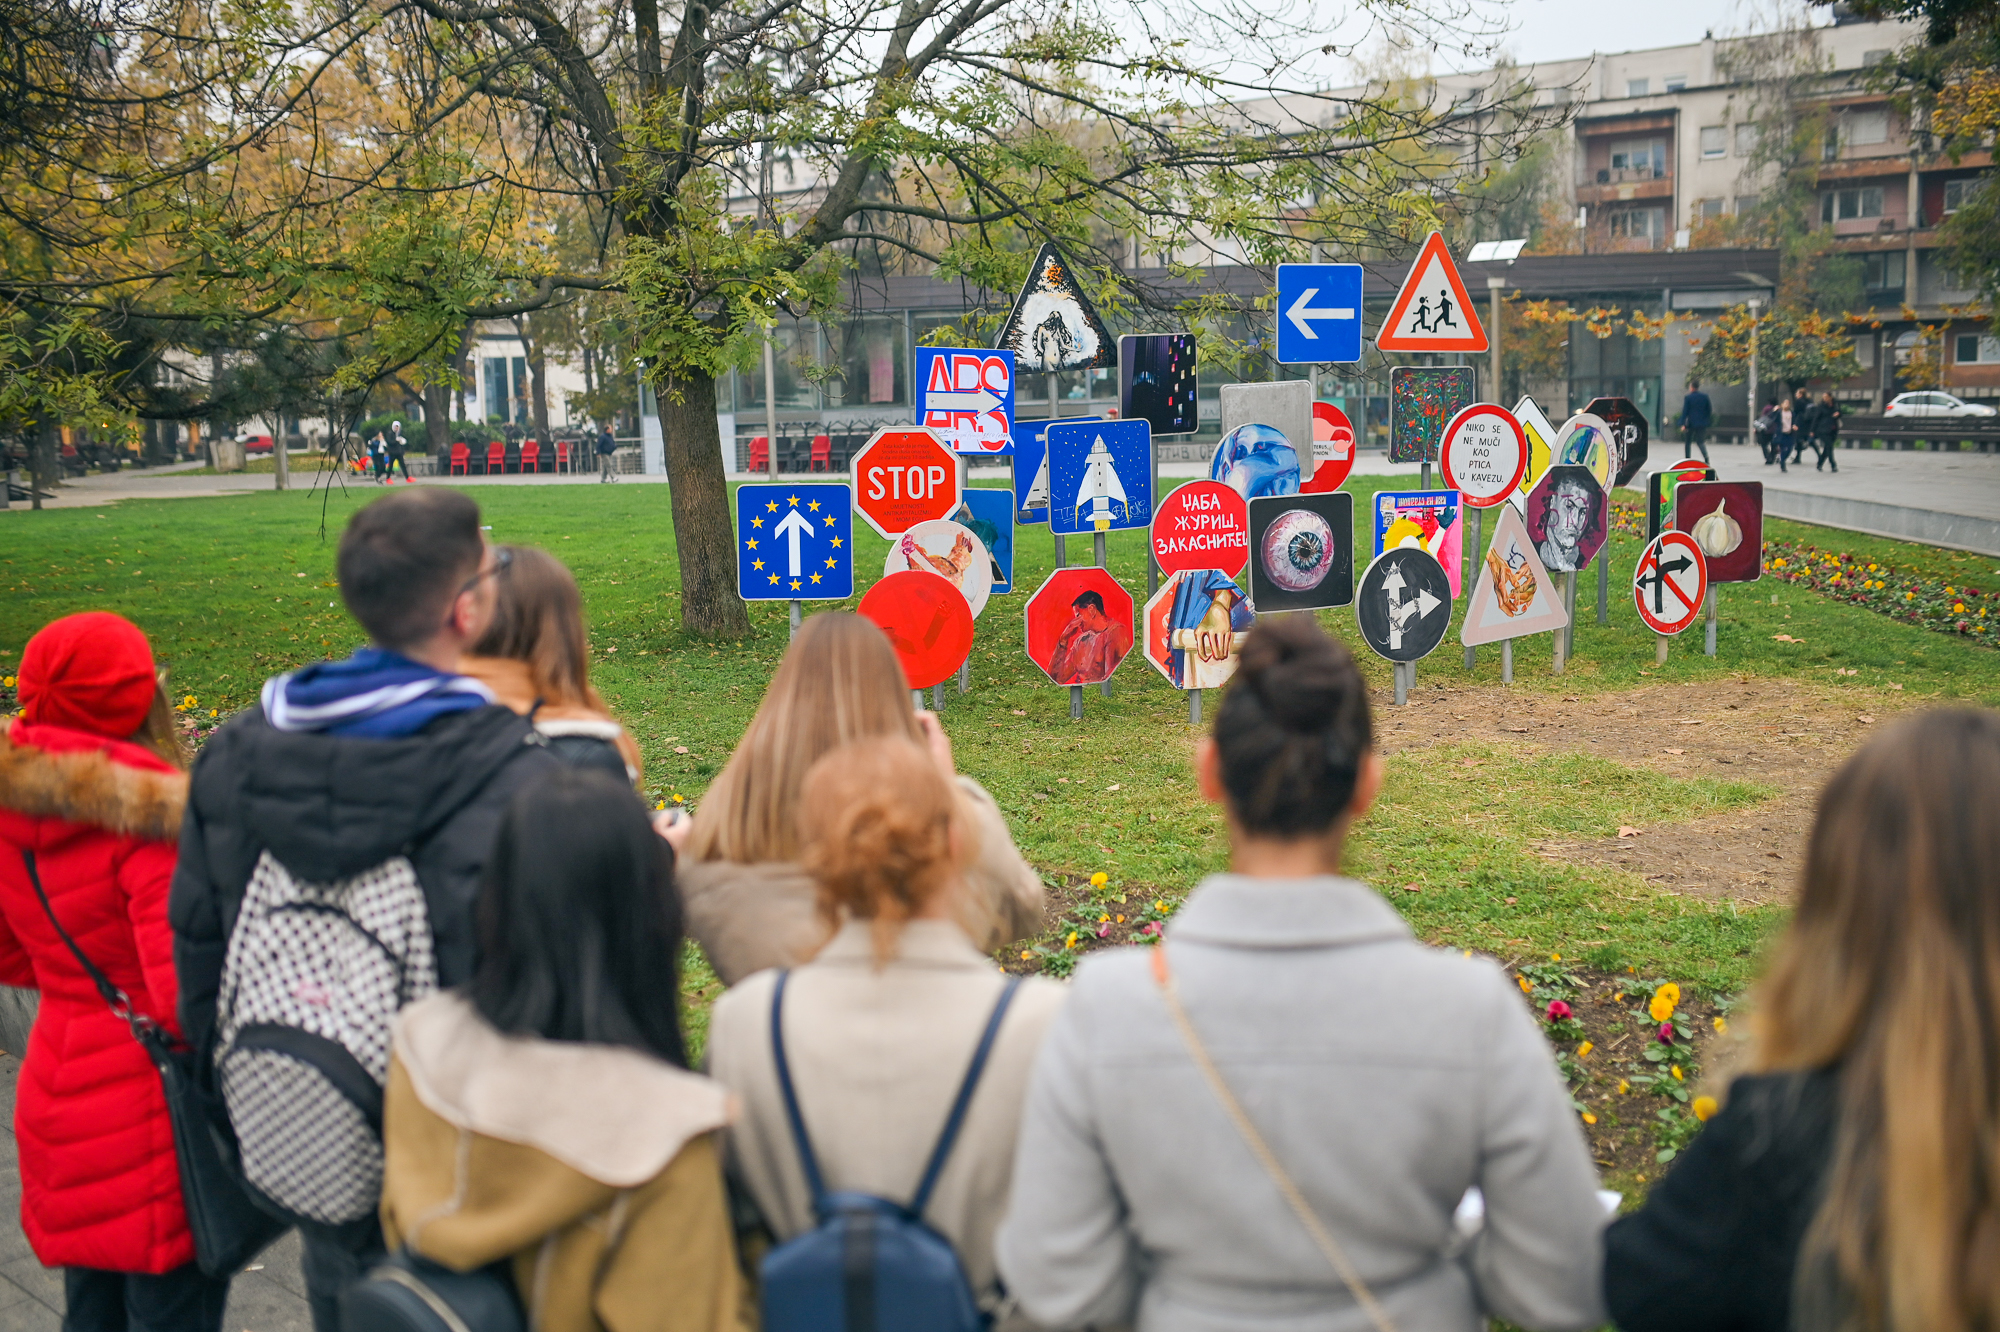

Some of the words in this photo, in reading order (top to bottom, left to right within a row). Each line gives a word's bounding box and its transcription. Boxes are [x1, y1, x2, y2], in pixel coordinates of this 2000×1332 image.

[1465, 423, 1485, 432] NIKO
[1492, 424, 1501, 433] SE
[1463, 437, 1473, 445] NE
[1478, 437, 1500, 446] MUČI
[1472, 448, 1489, 457] KAO
[1468, 460, 1491, 469] PTICA
[1459, 472, 1465, 480] U
[1471, 473, 1504, 483] KAVEZU.
[868, 466, 945, 500] STOP
[1174, 513, 1239, 531] ЖУРИШ,
